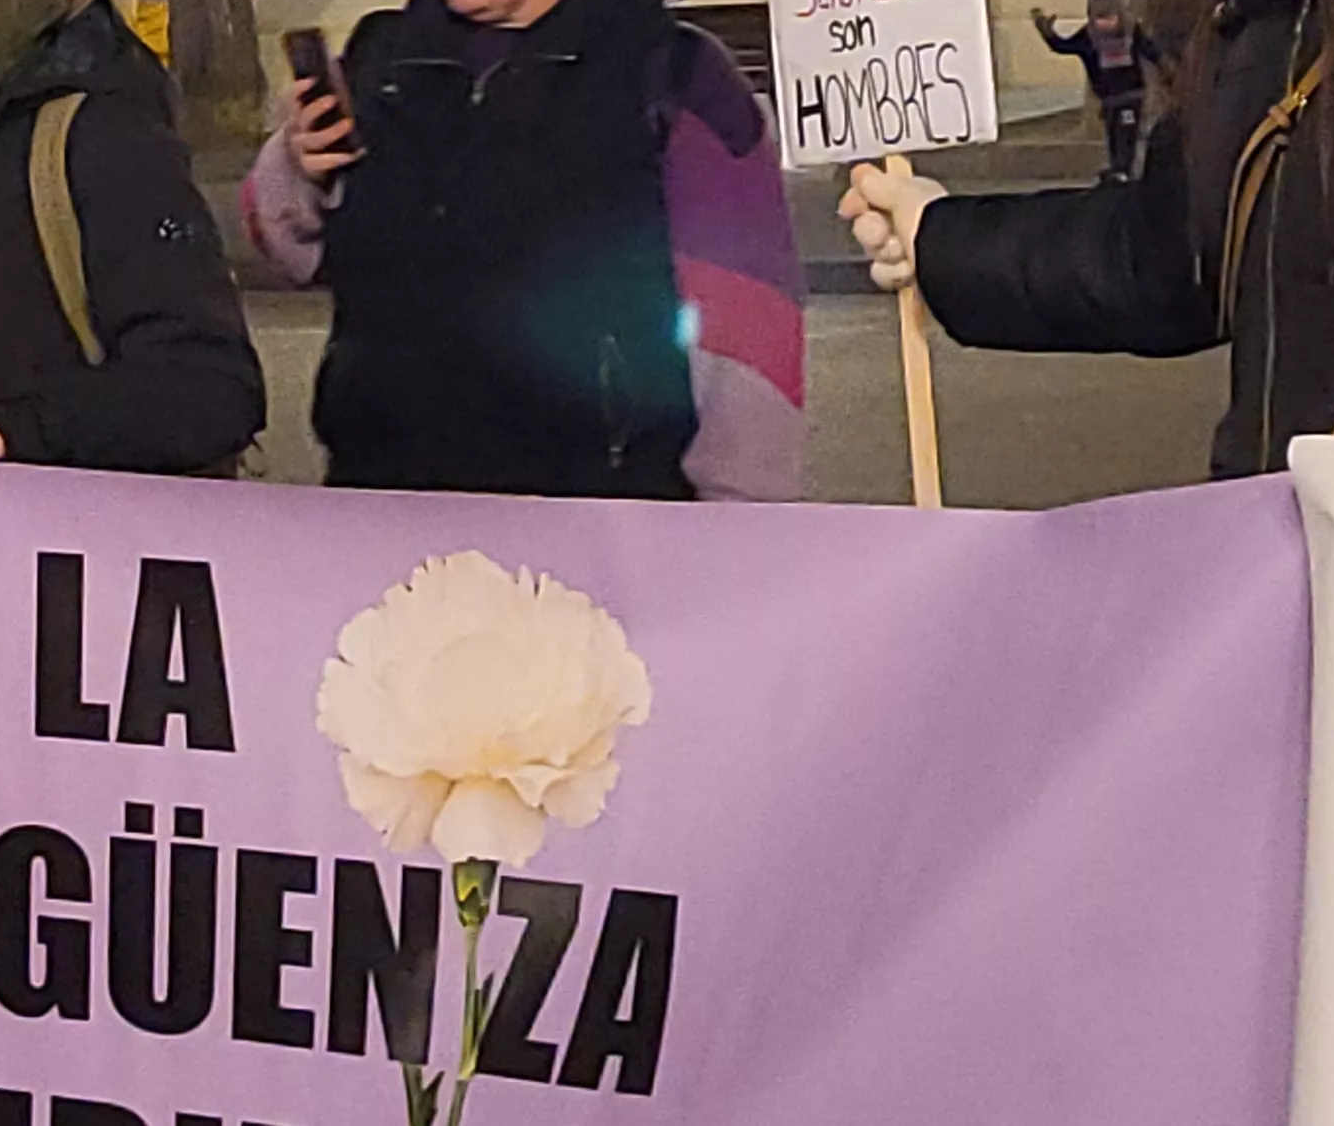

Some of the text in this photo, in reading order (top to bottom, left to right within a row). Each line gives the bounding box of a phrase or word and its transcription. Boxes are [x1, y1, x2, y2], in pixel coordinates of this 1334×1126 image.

[827, 14, 877, 53] son
[795, 41, 971, 151] HOMBRES
[34, 551, 237, 753] LA
